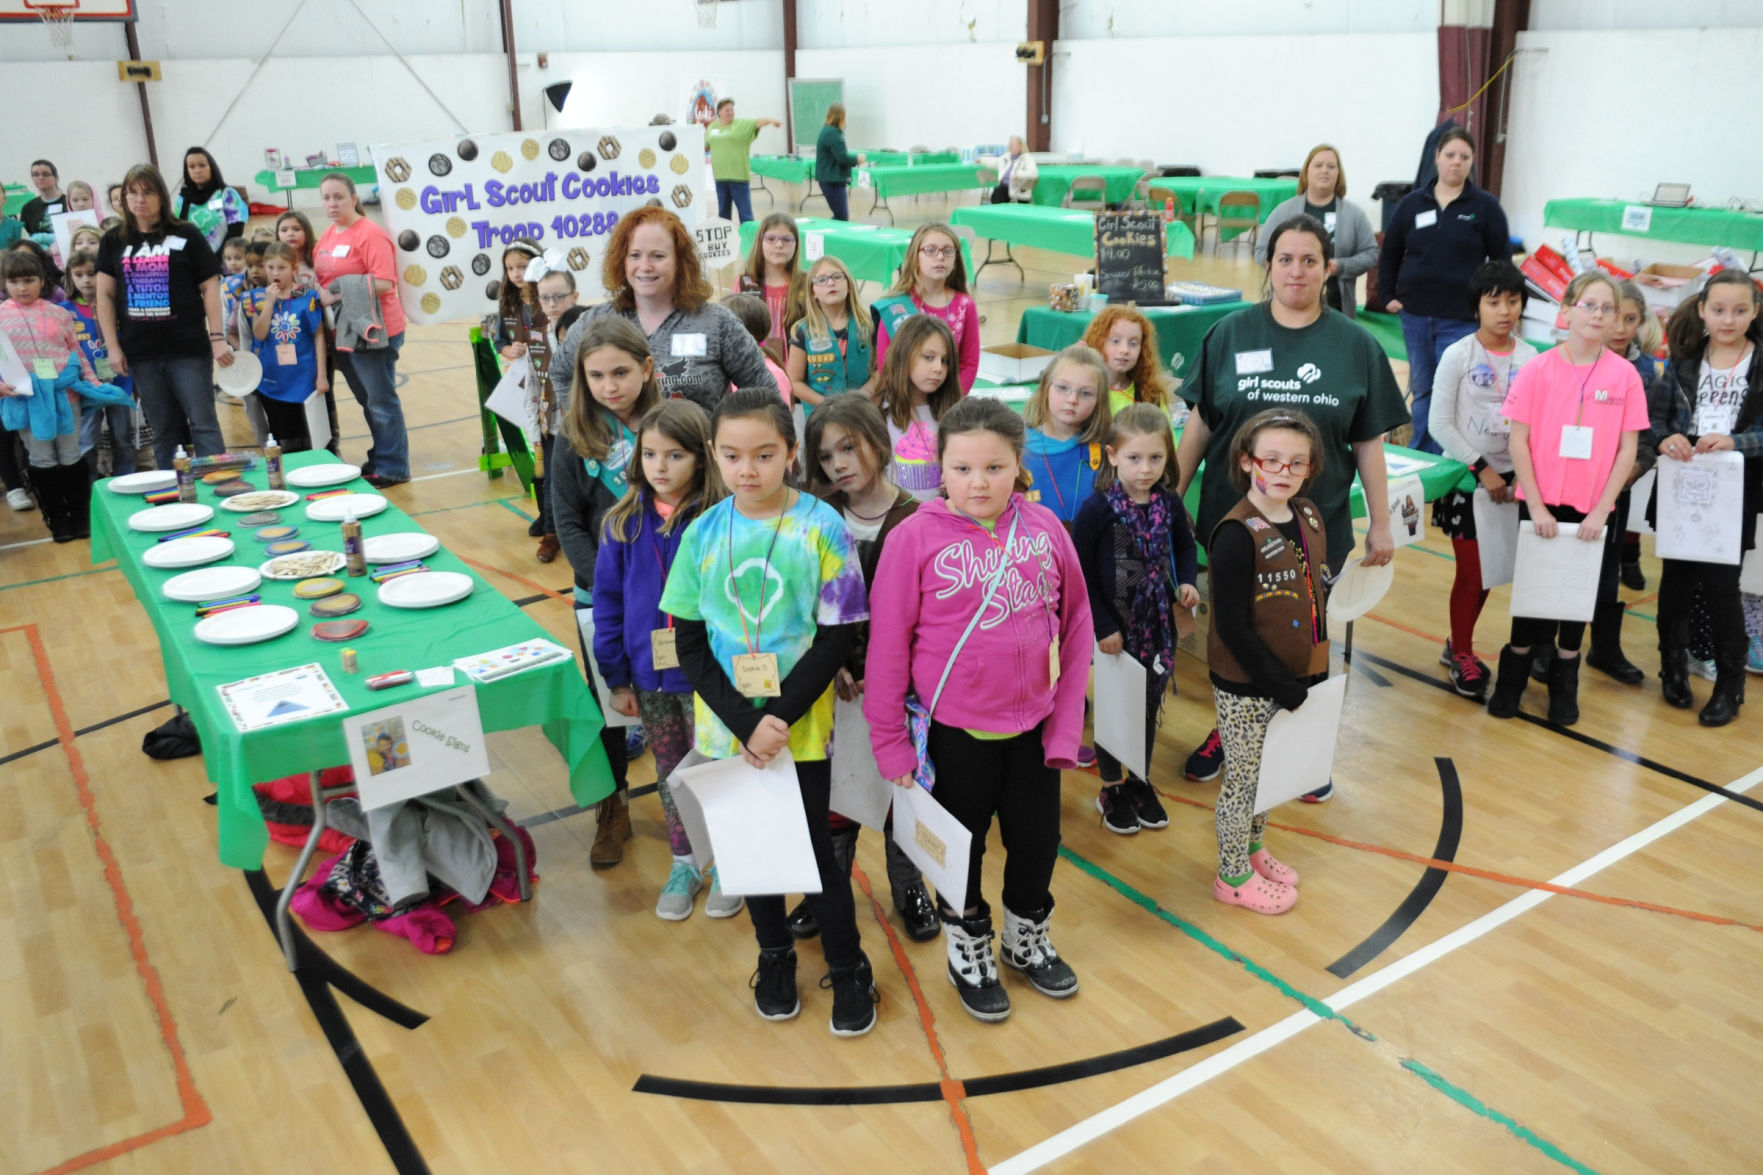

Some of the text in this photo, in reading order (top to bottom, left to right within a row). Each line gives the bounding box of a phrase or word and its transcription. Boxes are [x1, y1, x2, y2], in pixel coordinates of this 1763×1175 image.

[484, 172, 558, 207] Scout
[562, 170, 660, 200] Cookies
[1098, 215, 1158, 231] Girl Scout
[472, 220, 544, 249] Troop
[696, 226, 732, 243] STOP
[1102, 231, 1156, 246] Cookies
[122, 244, 170, 257] I AM
[708, 241, 727, 251] BUY
[132, 256, 169, 264] LEADER
[136, 263, 169, 272] MOM
[136, 284, 169, 292] TUTOR
[135, 299, 170, 307] FRIEND
[1238, 376, 1301, 391] girl scouts
[1699, 374, 1749, 390] AGIC
[1247, 389, 1339, 406] of western ohio
[934, 532, 1053, 599] Shining
[1258, 568, 1296, 583] 11550
[412, 720, 446, 742] Cookie
